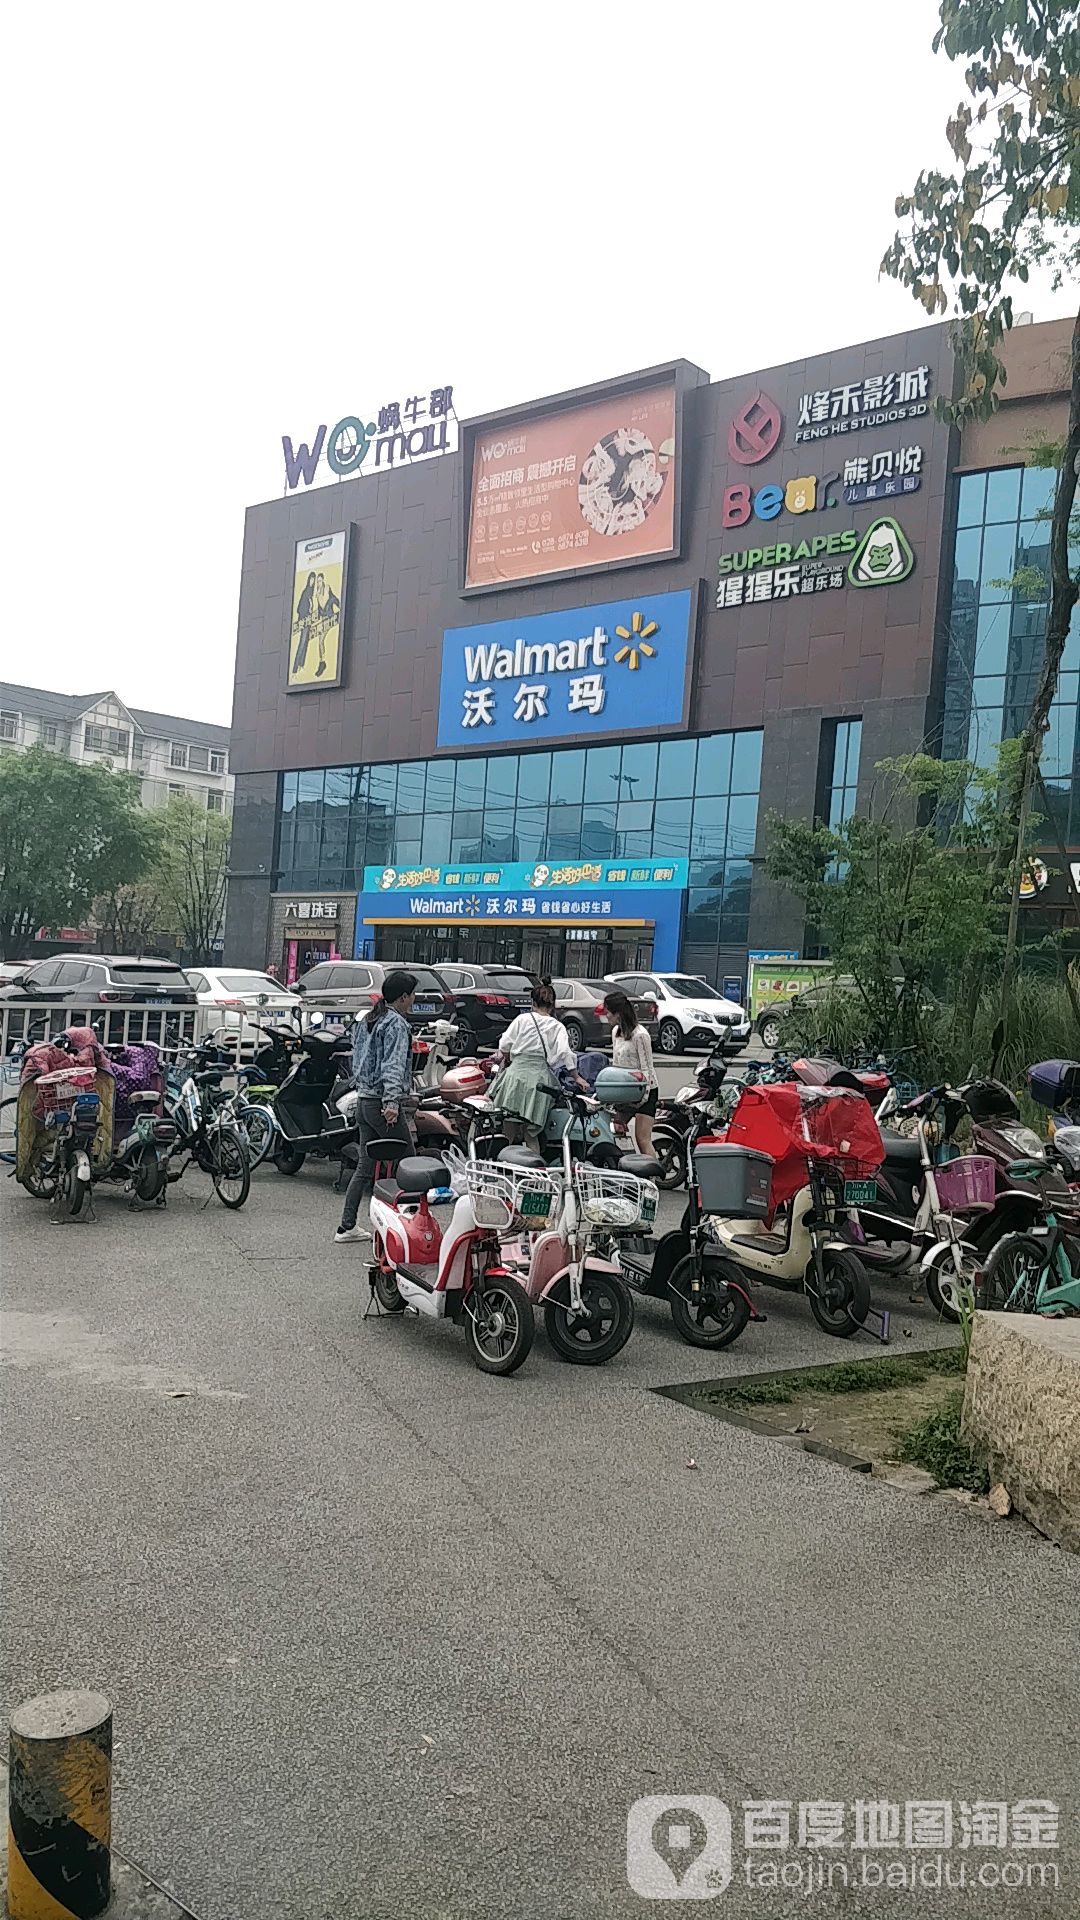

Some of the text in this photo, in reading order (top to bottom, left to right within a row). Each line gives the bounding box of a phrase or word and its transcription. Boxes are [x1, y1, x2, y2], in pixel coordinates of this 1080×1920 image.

[798, 365, 929, 427] 烽禾影城
[795, 403, 926, 443] FENG HE STUDIOS 3D
[477, 467, 524, 493] 全面招商
[843, 445, 922, 486] 熊贝悦
[847, 478, 916, 501] 儿童乐园
[716, 565, 800, 608] 猩猩乐
[801, 573, 843, 593] 超乐场
[464, 626, 608, 683] Walmart
[461, 674, 606, 728] 沃尔玛
[285, 901, 338, 919] 六喜珠宝
[410, 898, 464, 914] Walmart
[486, 897, 612, 914] 沃尔玛 省钱省心好生活
